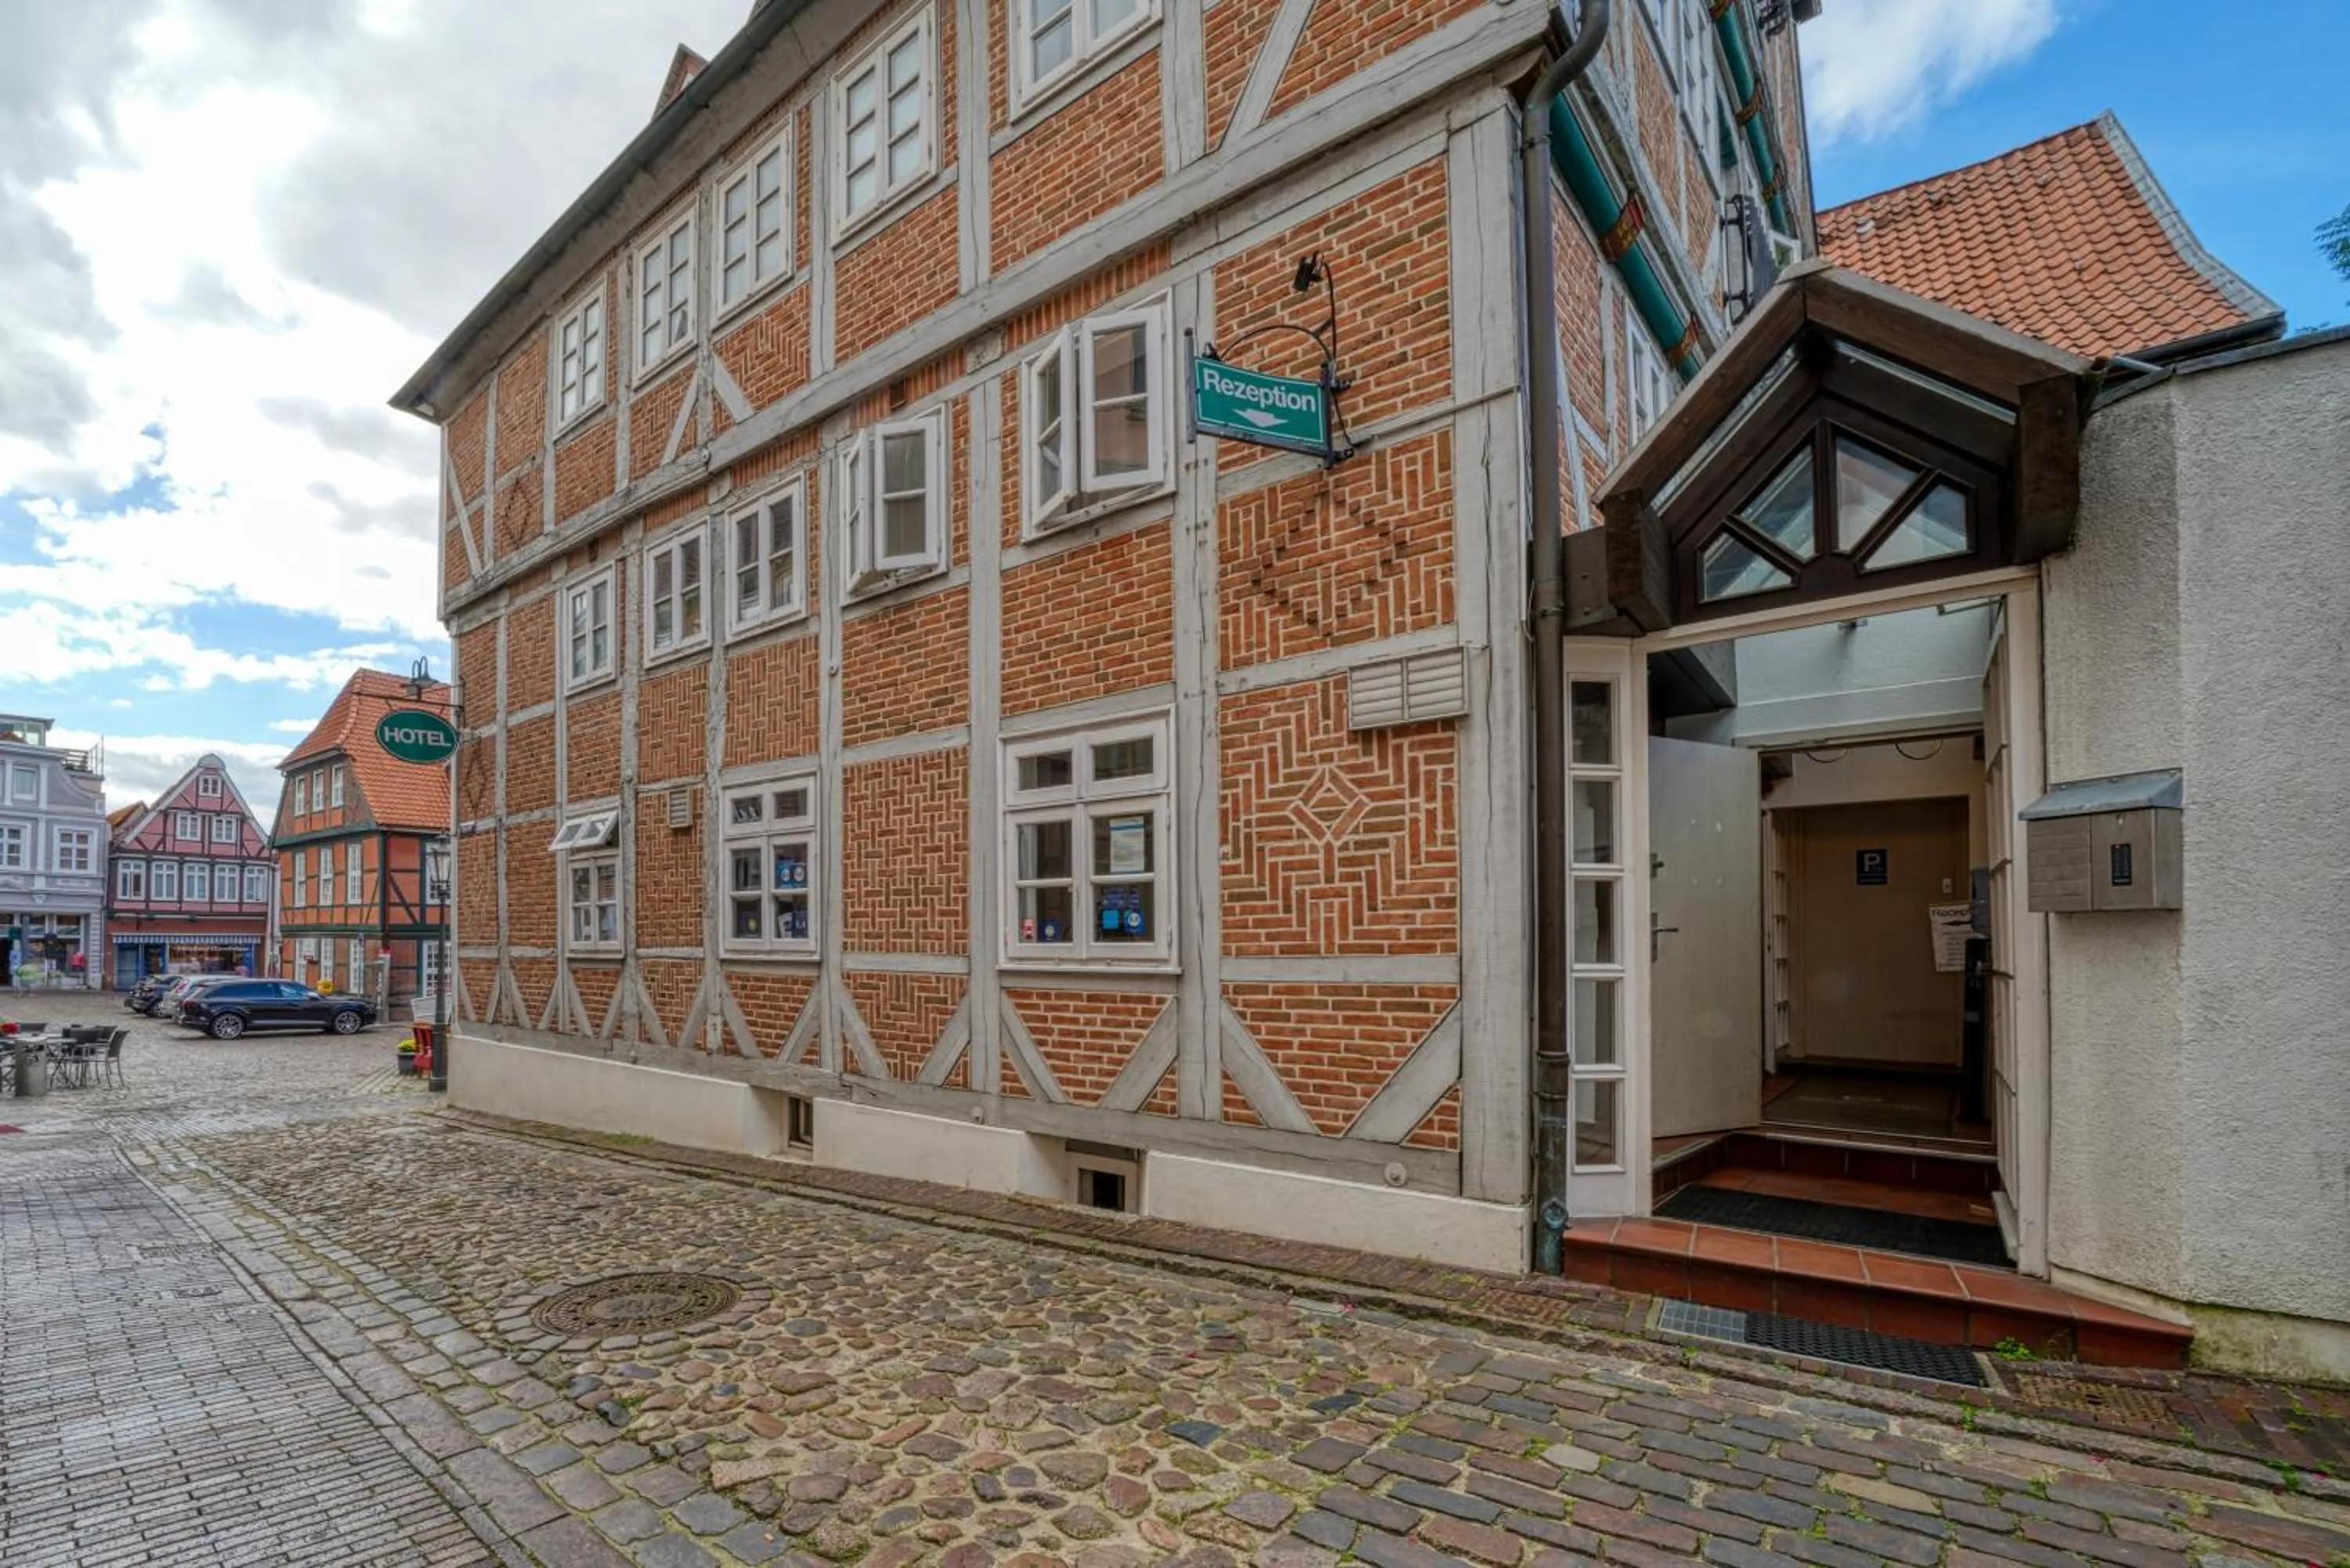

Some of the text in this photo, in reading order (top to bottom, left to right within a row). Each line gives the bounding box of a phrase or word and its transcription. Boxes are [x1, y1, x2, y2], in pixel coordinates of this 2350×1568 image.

[1202, 368, 1316, 413] Rezeption
[384, 726, 452, 746] HOTEL
[1864, 853, 1881, 872] P
